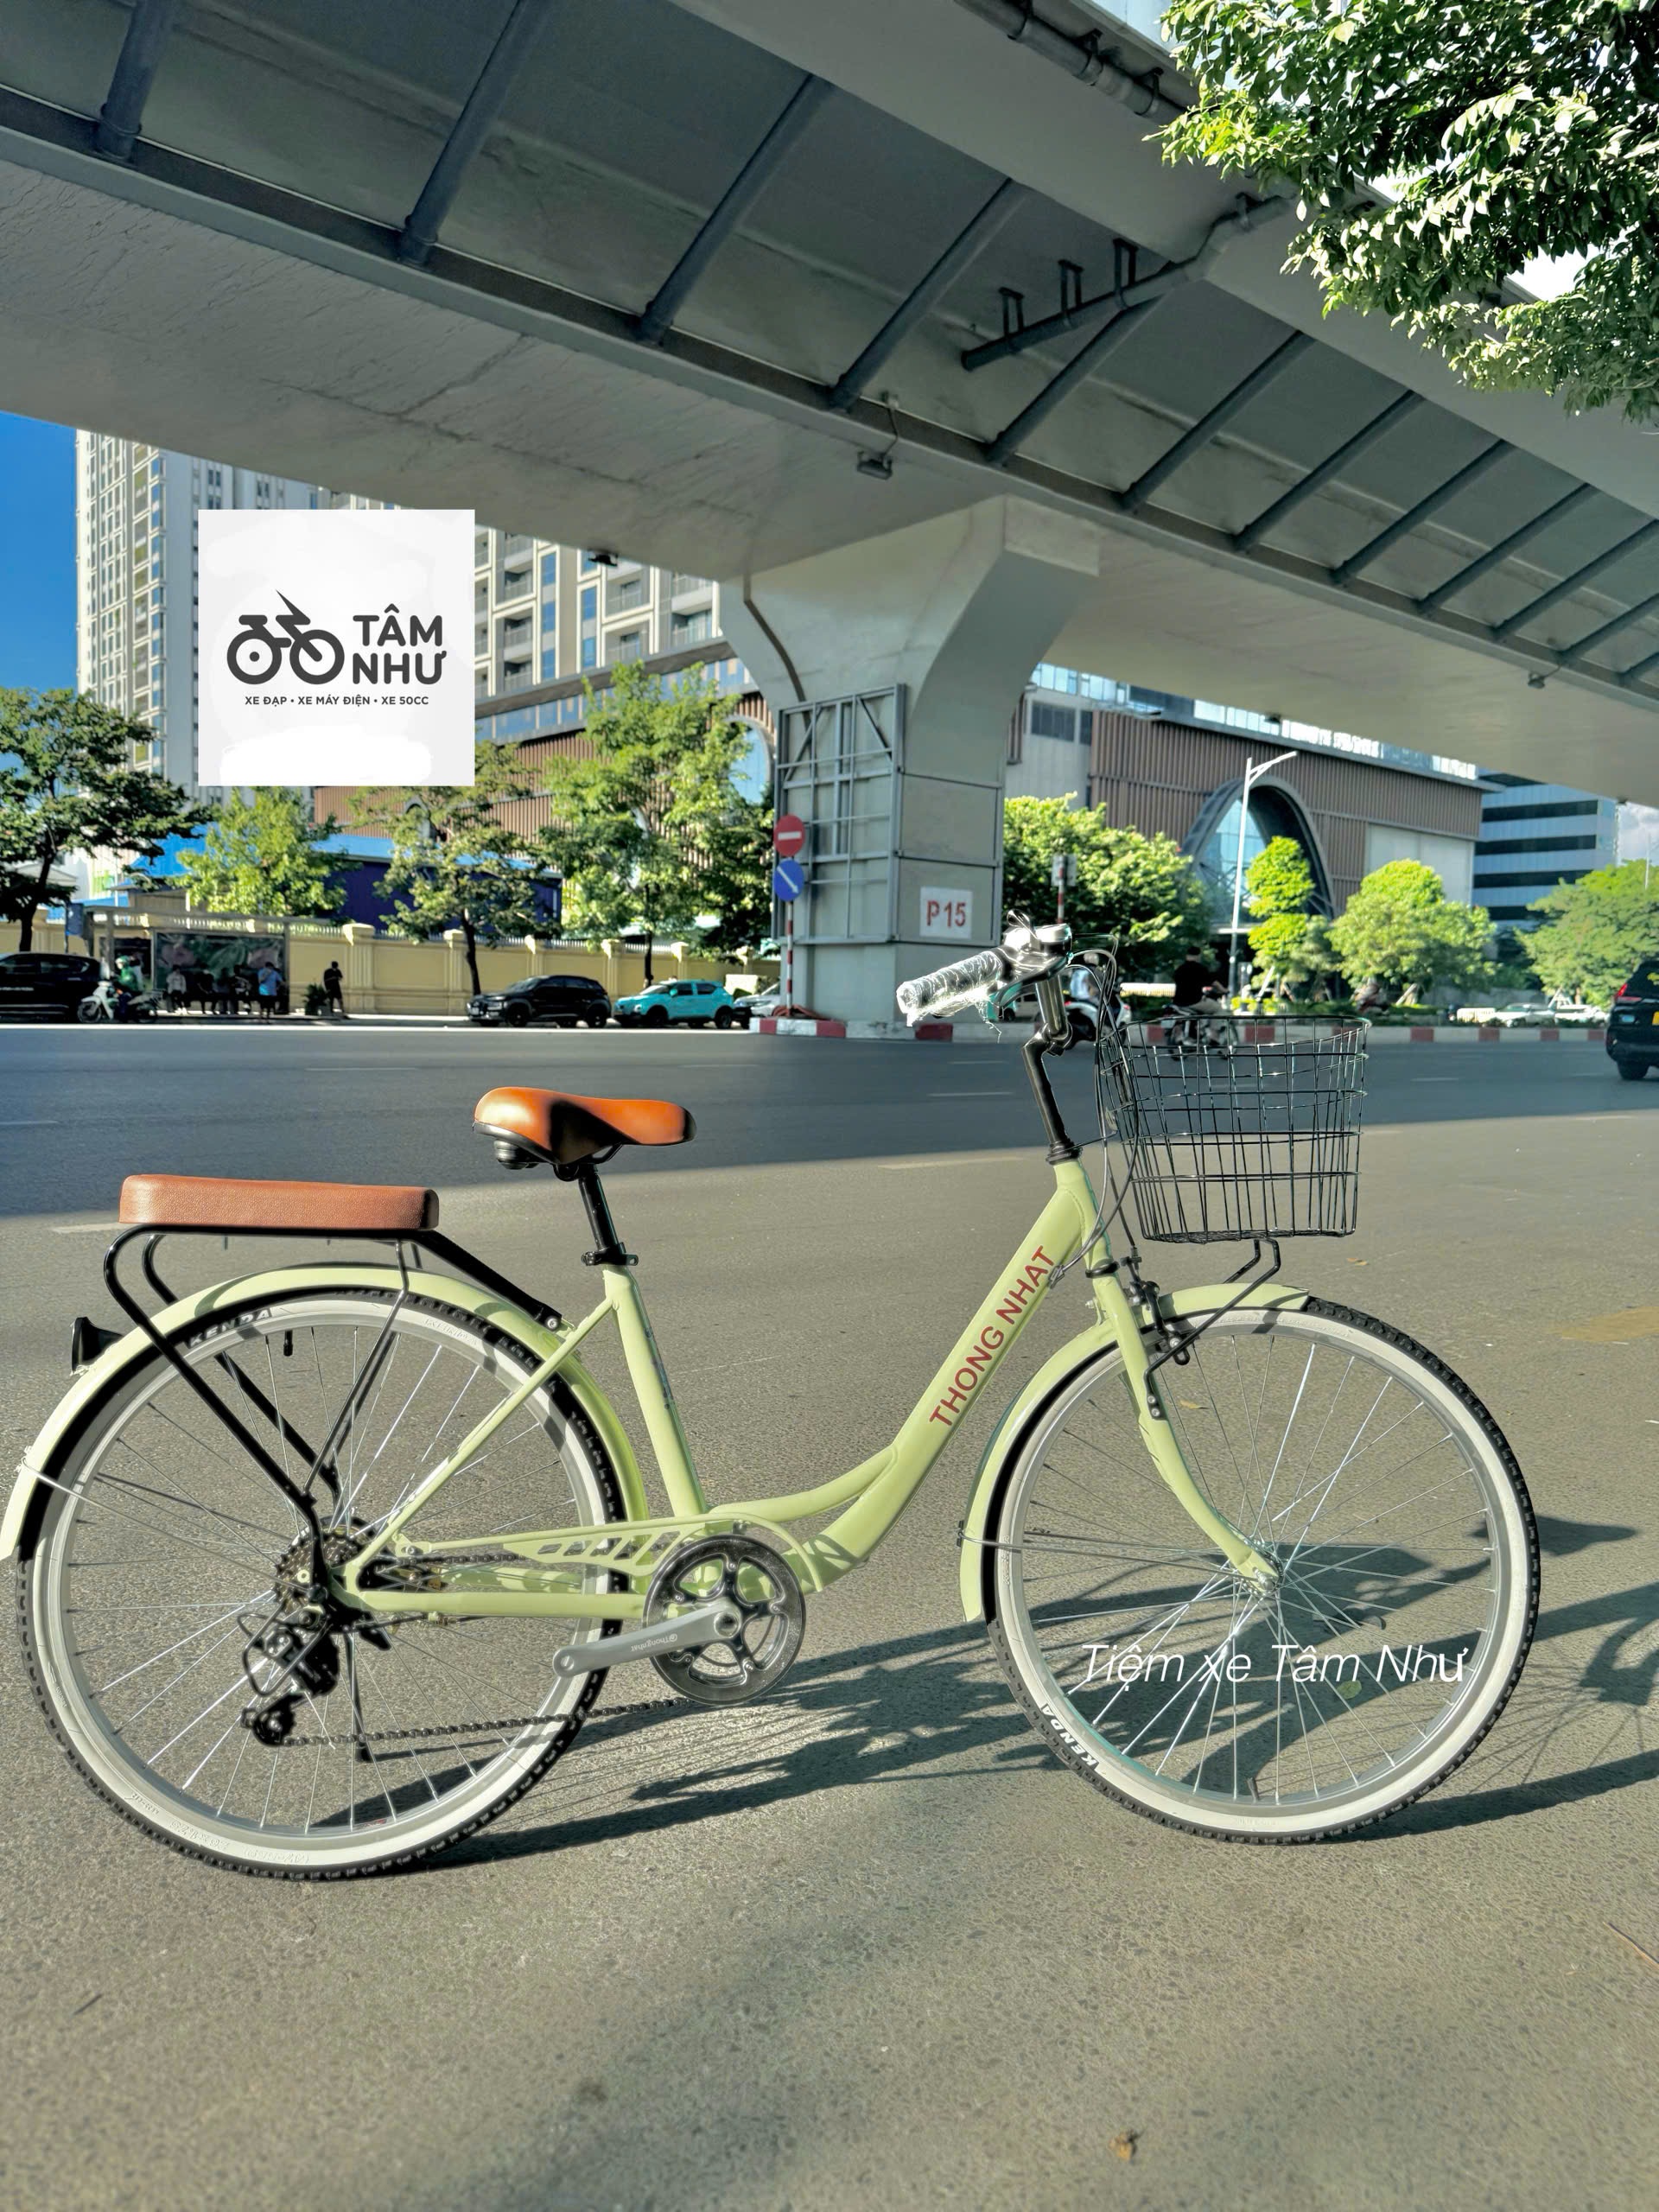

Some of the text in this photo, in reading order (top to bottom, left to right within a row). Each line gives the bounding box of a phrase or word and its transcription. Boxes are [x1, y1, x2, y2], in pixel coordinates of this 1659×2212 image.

[926, 900, 966, 927] P15
[190, 1309, 270, 1347] KENDA
[929, 1245, 1054, 1427] THONG NHAT
[1041, 1705, 1097, 1766] KENDA
